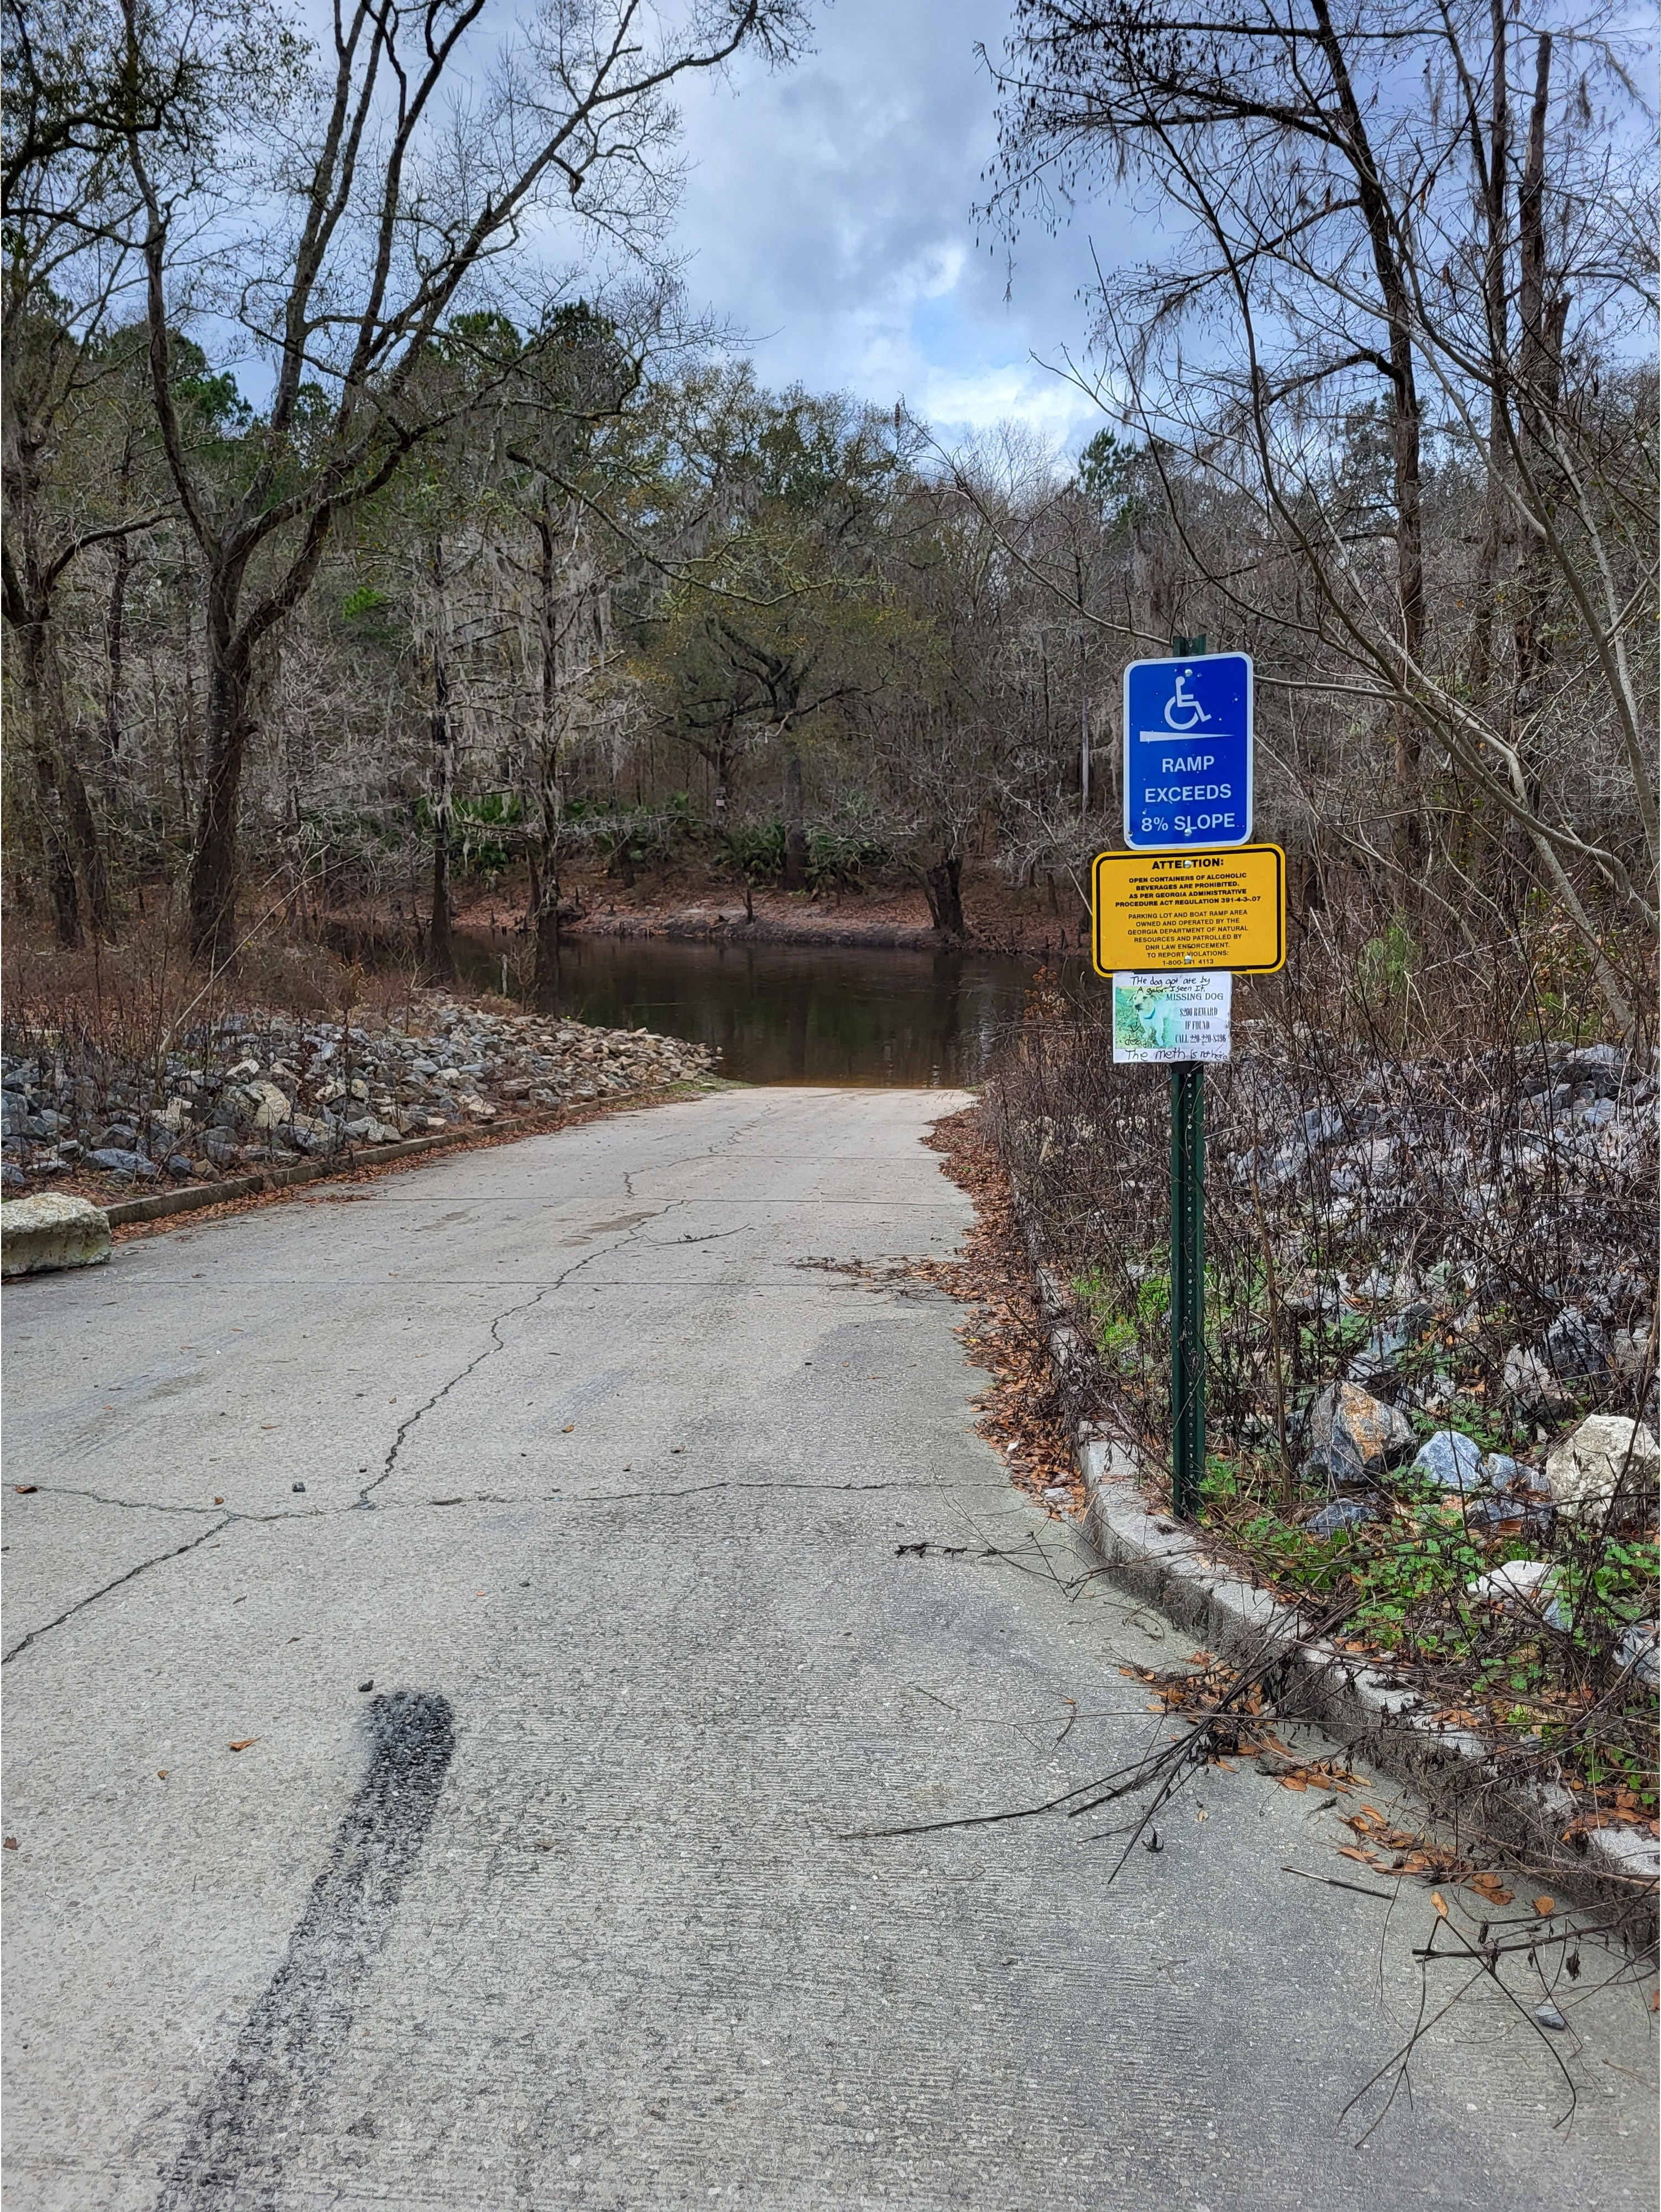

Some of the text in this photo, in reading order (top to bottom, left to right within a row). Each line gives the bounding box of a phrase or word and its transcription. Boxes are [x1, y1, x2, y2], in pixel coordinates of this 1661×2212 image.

[1162, 756, 1214, 773] RAMP
[1145, 784, 1231, 802] EXCEEDS
[1141, 813, 1235, 832] 8% SLOPE
[1150, 976, 1162, 988] dog
[1200, 976, 1210, 986] by
[1179, 1007, 1218, 1016] $200 REWARD
[1185, 1020, 1210, 1030] IF FOUND
[1175, 1034, 1189, 1043] CALL
[1125, 1048, 1148, 1061] The
[1156, 1047, 1185, 1060] meth
